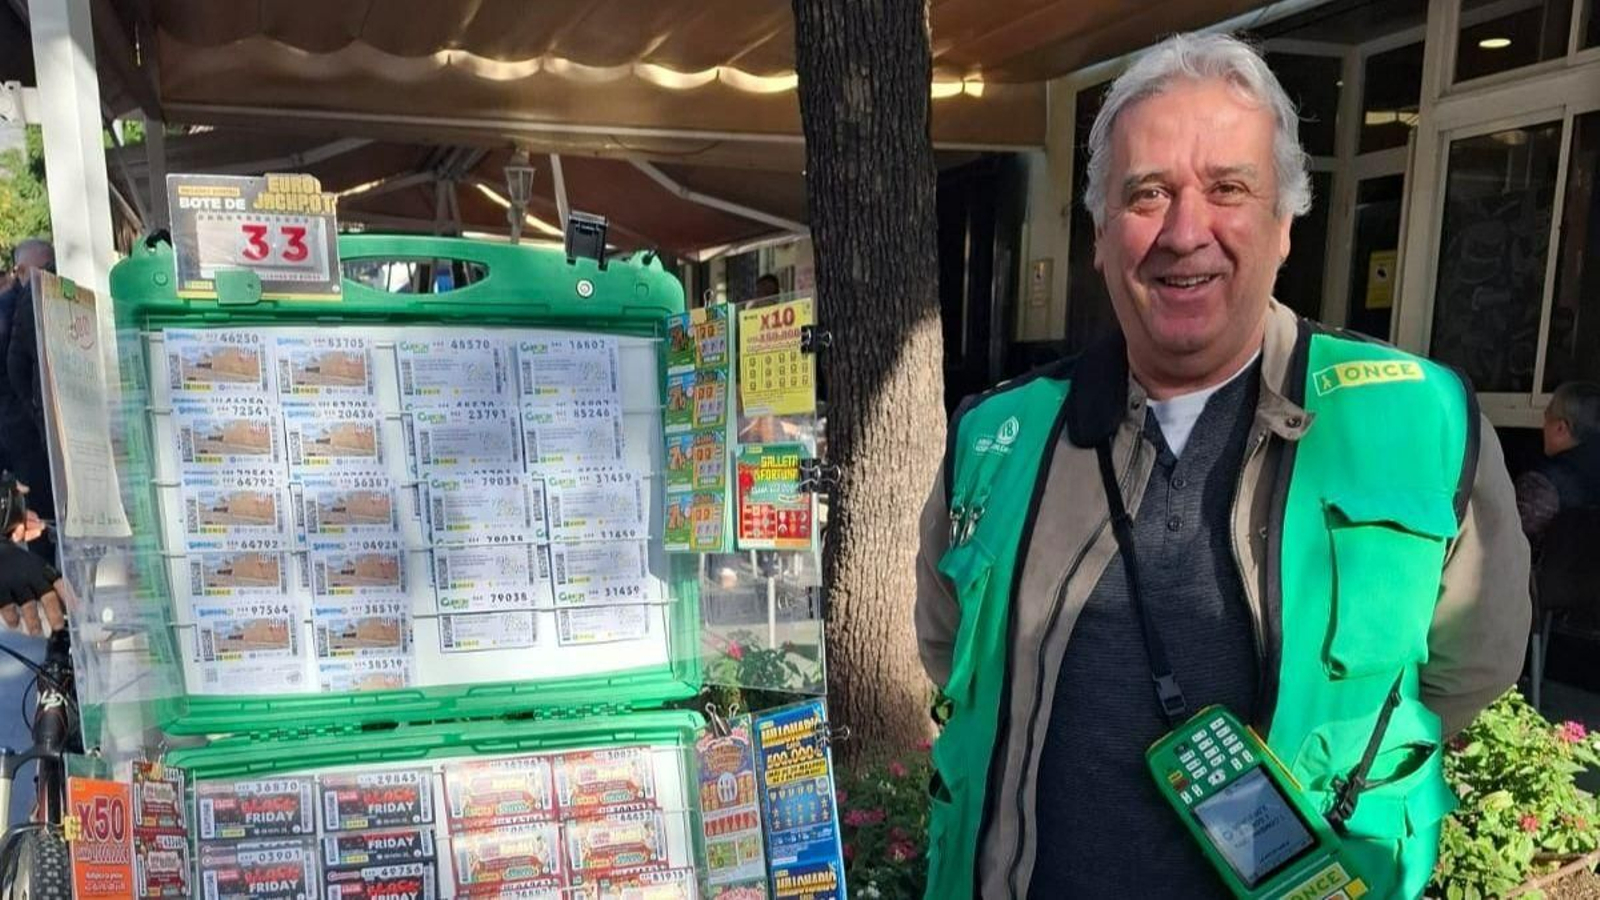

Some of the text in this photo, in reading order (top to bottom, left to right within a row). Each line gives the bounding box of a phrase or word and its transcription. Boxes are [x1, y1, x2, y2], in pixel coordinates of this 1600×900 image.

[268, 175, 321, 194] EURO
[180, 198, 246, 211] BOTE DE
[1344, 364, 1417, 382] ONCE
[761, 716, 818, 749] MILLONARI
[368, 801, 415, 814] FRIDAY
[76, 795, 127, 841] x50
[246, 811, 295, 824] FRIDAY
[368, 837, 415, 849] FRIDAY
[249, 879, 298, 893] FRIDAY
